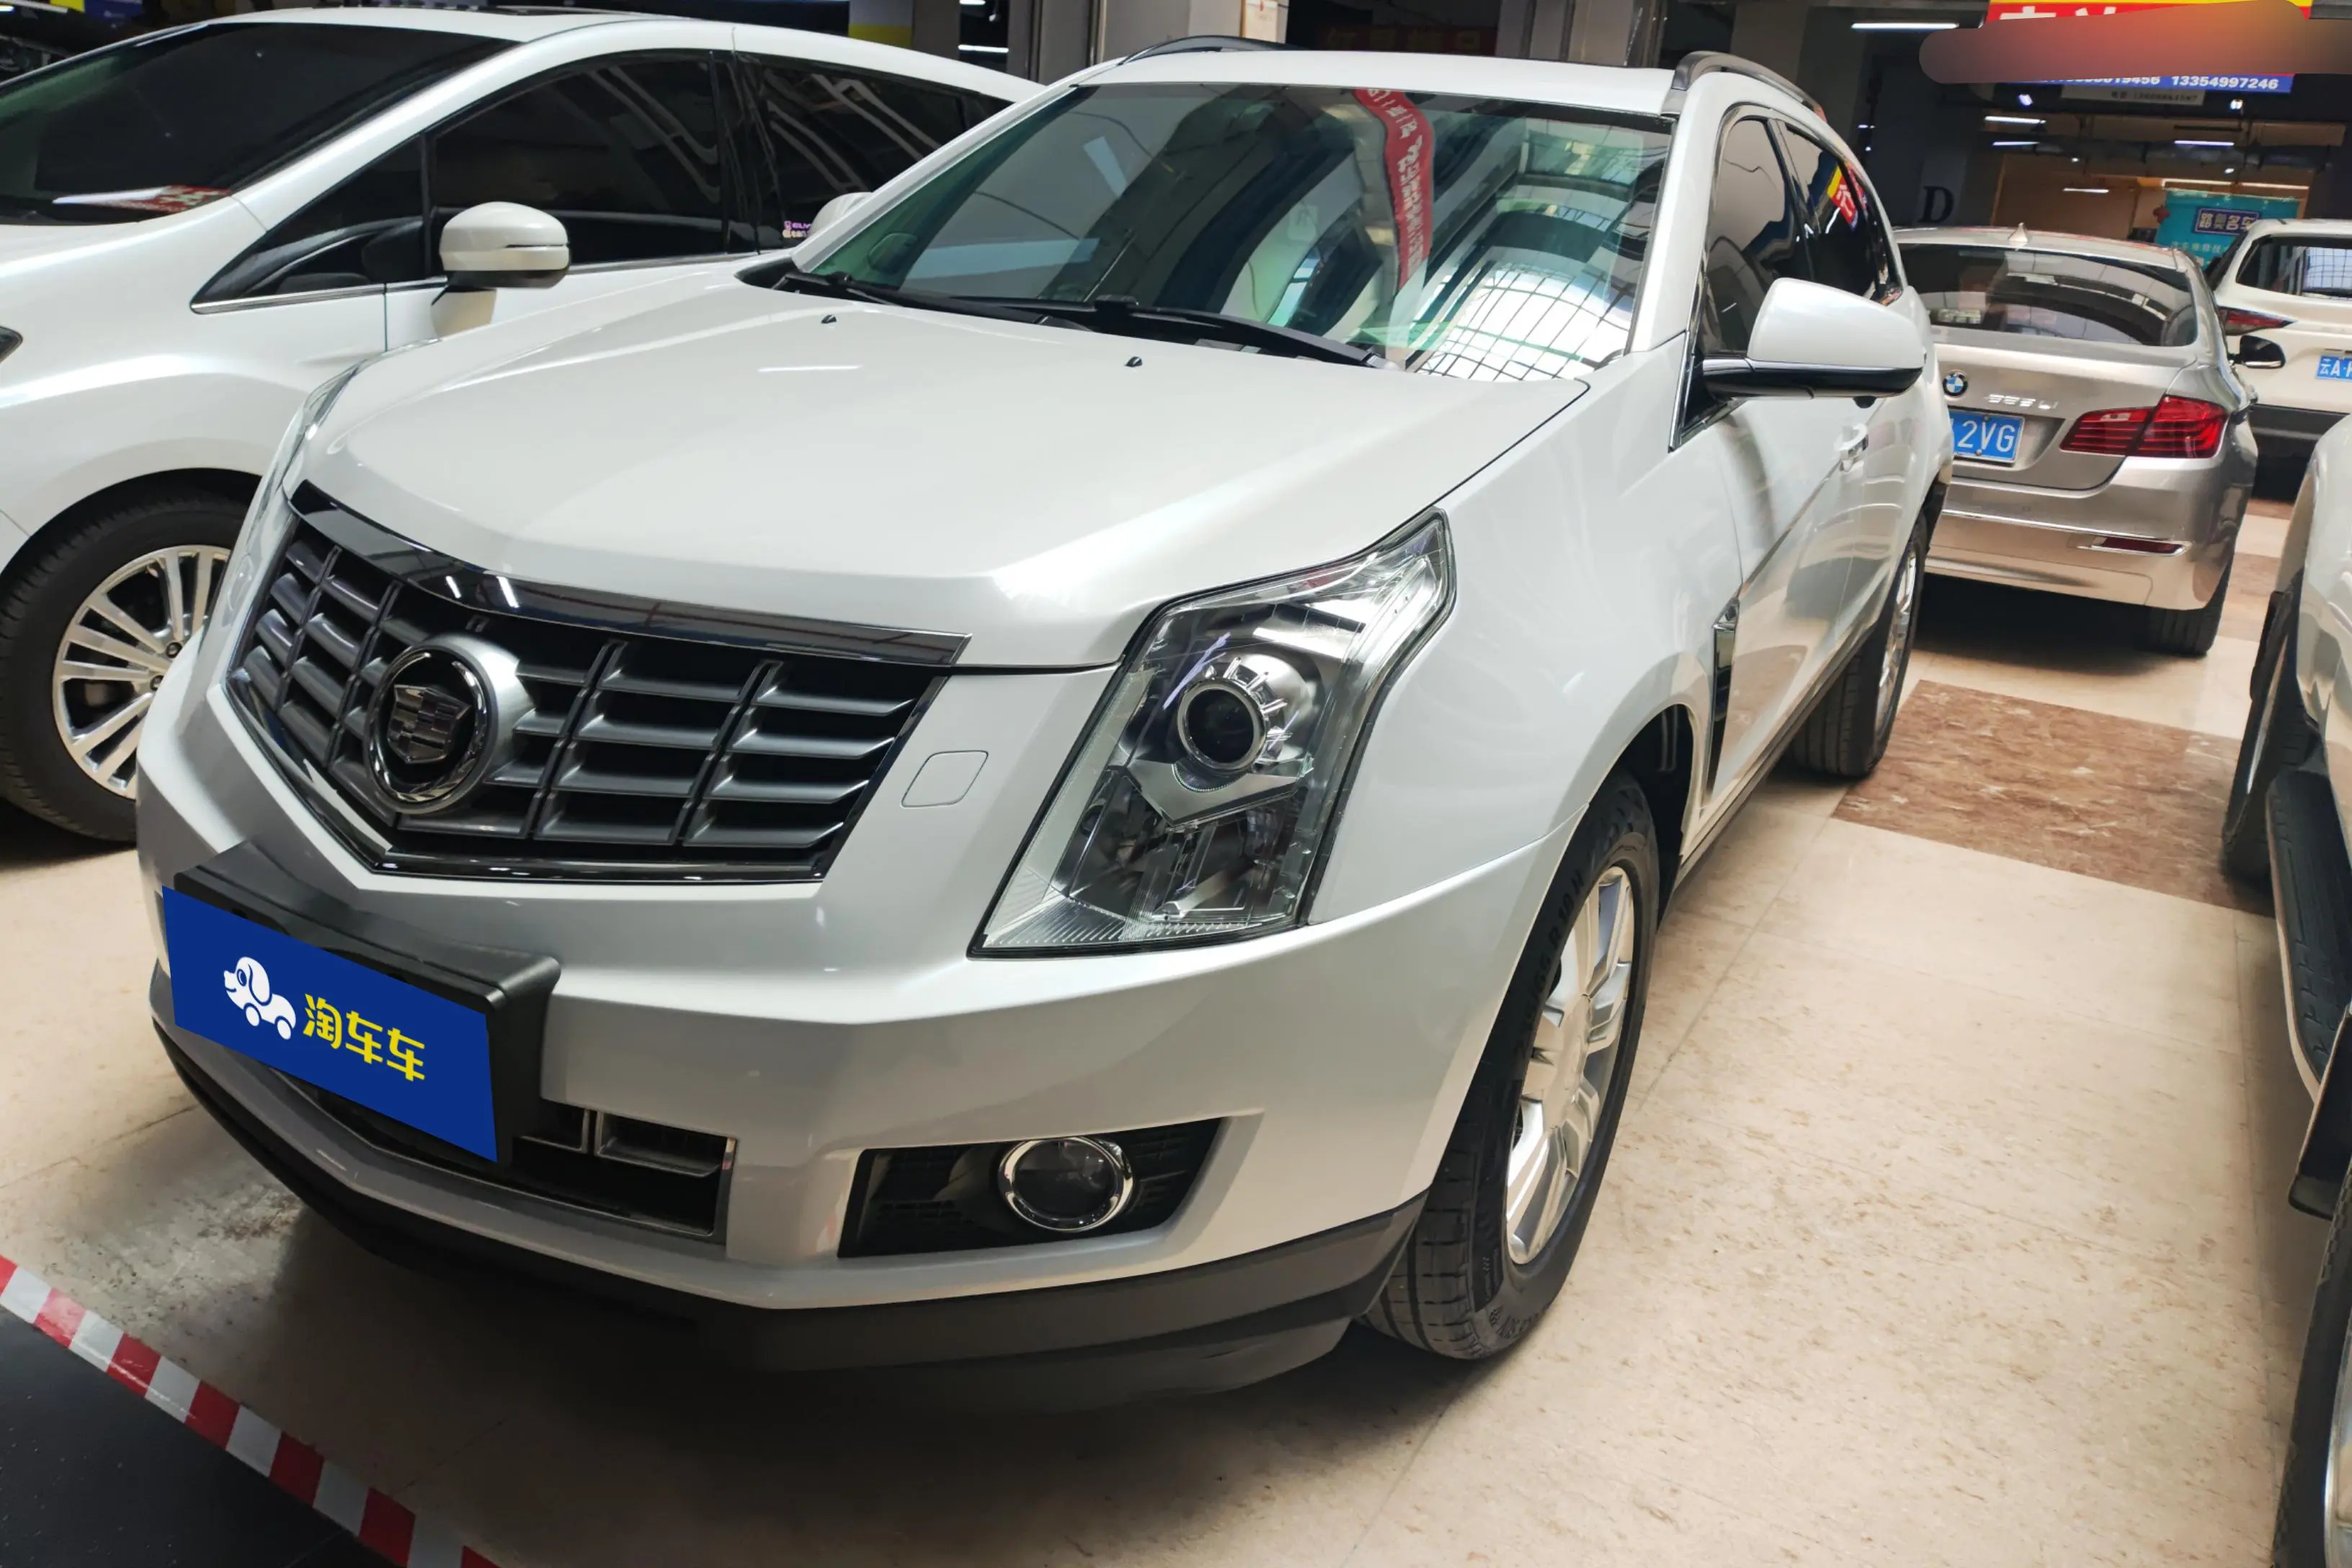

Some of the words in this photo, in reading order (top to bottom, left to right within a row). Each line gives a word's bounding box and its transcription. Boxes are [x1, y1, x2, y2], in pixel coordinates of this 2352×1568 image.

[2171, 76, 2278, 89] 13354997246
[1917, 186, 1954, 223] D
[1950, 418, 2015, 453] 2VG
